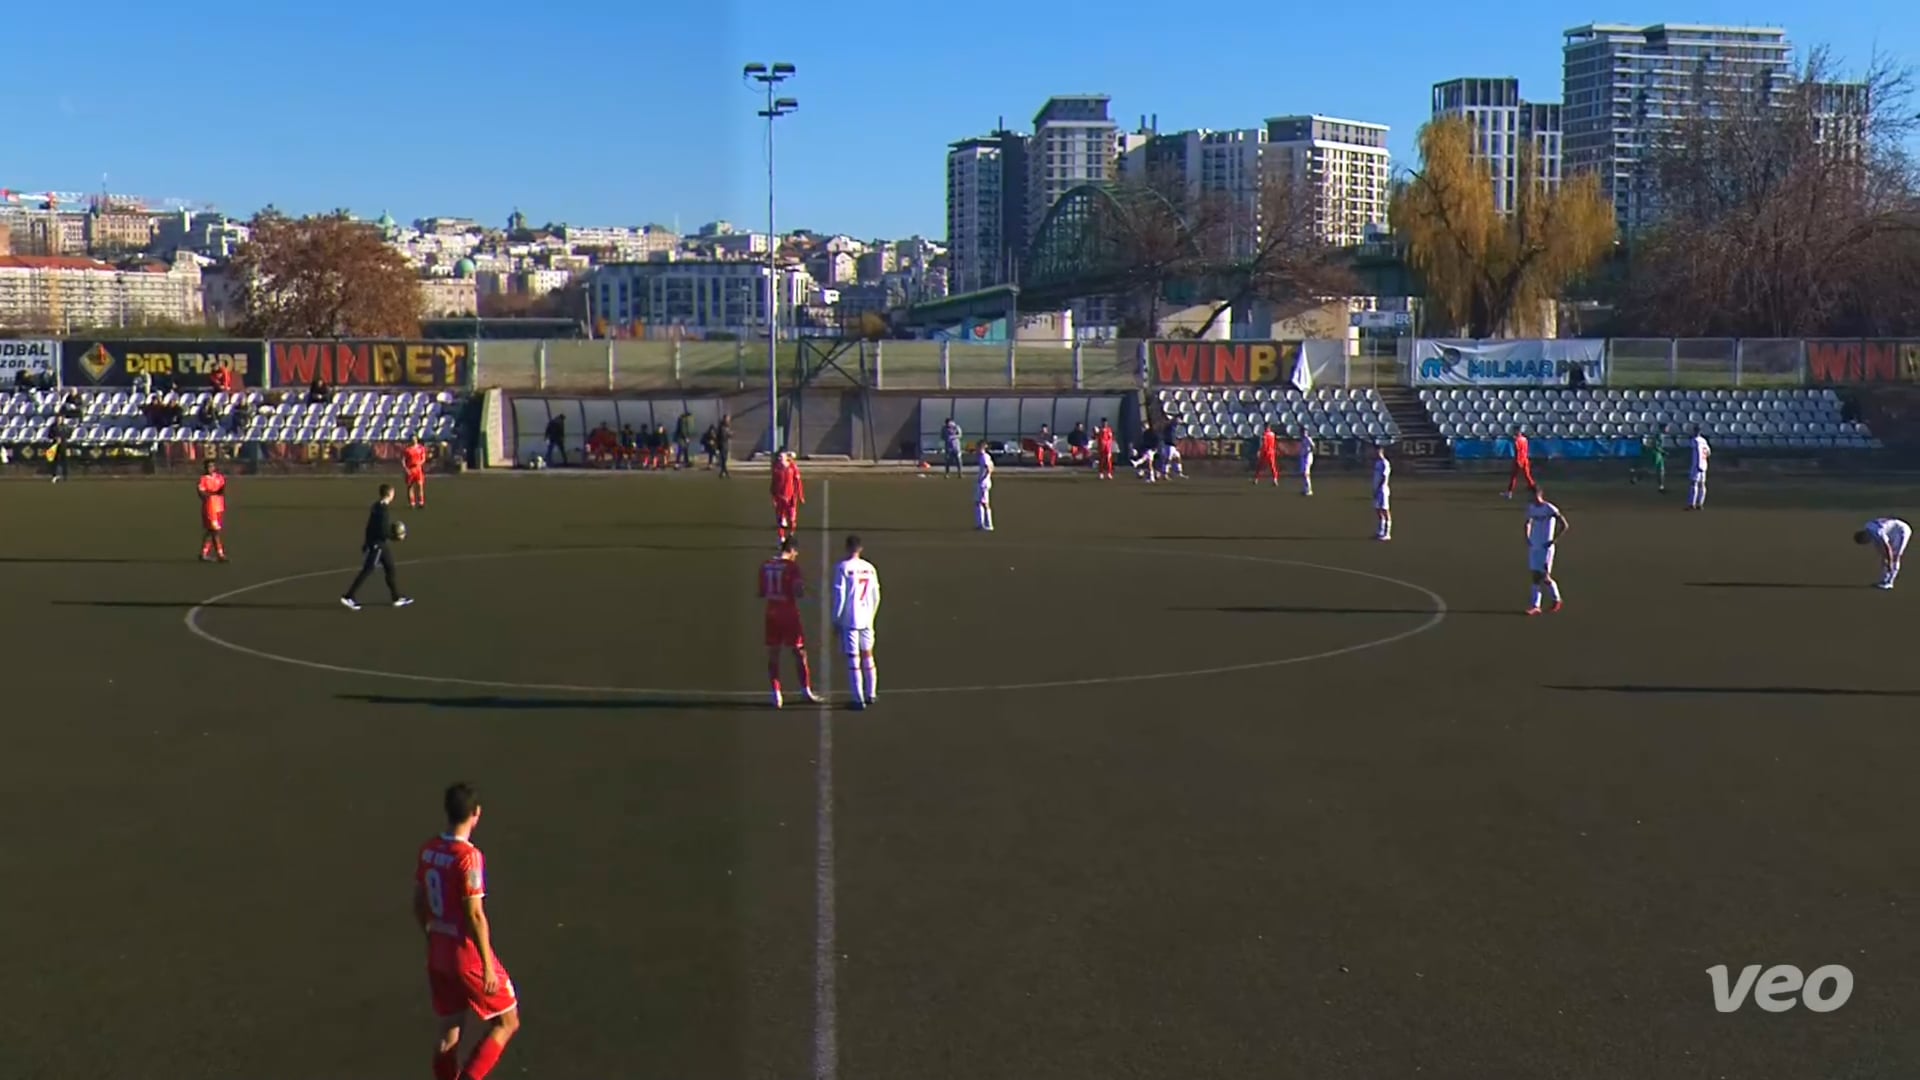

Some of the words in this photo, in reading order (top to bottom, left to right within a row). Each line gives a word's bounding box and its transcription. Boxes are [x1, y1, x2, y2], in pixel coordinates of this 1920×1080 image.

[276, 345, 465, 384] WINBET
[1467, 360, 1553, 378] MILMAR
[859, 578, 869, 600] 7
[426, 868, 443, 917] 8
